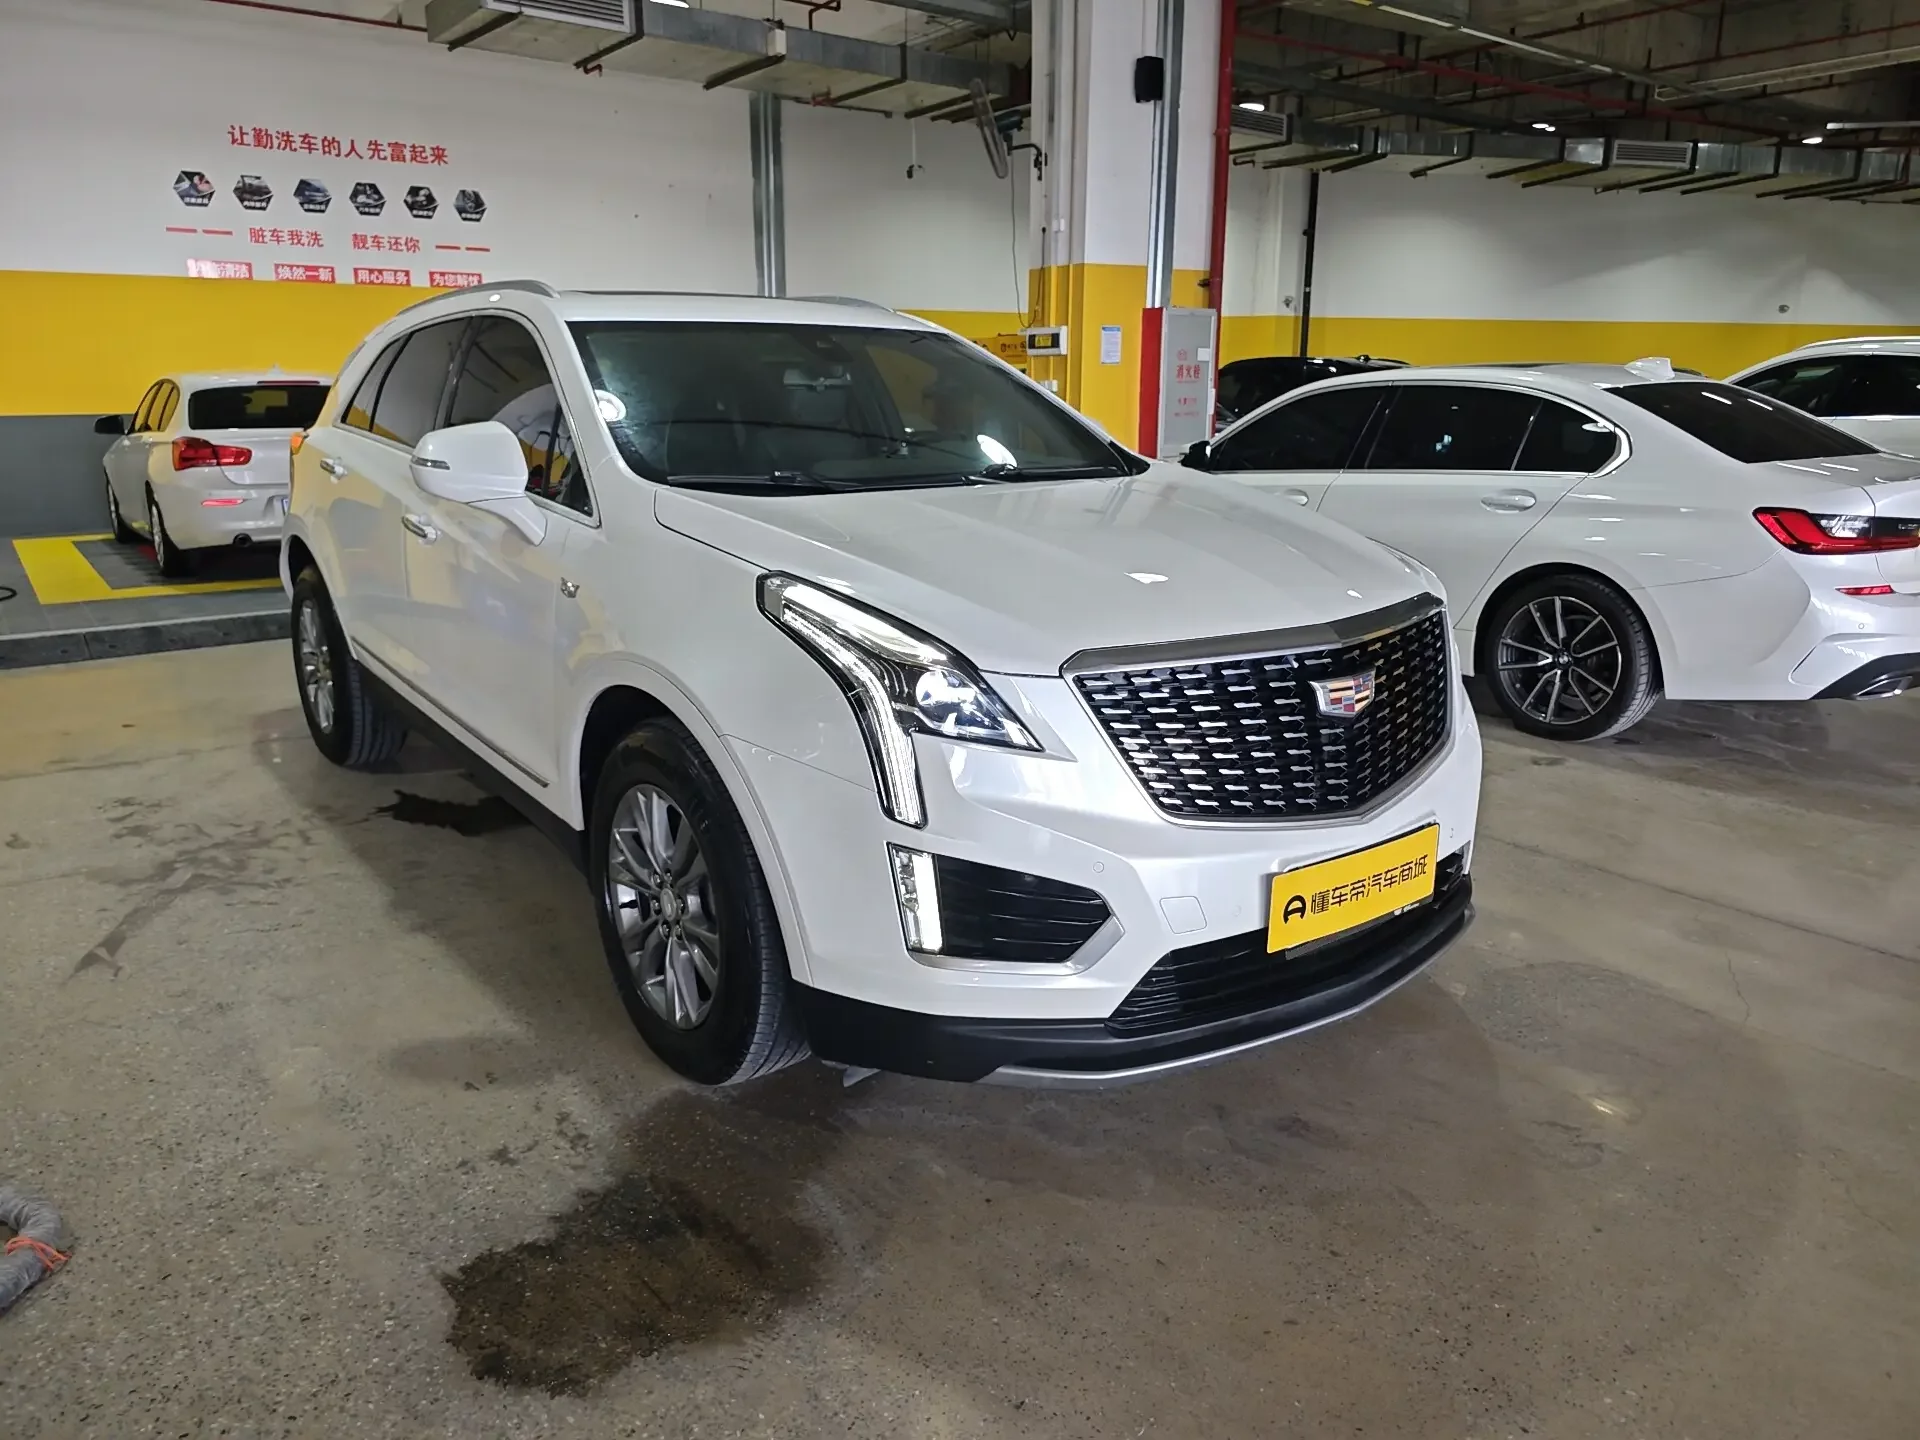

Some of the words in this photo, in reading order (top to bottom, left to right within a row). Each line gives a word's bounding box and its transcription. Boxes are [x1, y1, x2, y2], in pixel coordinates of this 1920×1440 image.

[228, 124, 449, 165] 让勤洗车的人先富起来
[249, 227, 324, 248] 脏车我洗
[351, 233, 421, 253] 靓车还你
[277, 265, 333, 282] 焕然一新
[357, 269, 409, 285] 用心服务
[1176, 364, 1201, 379] 消火栓
[1310, 854, 1428, 915] 懂车帝汽车商城
